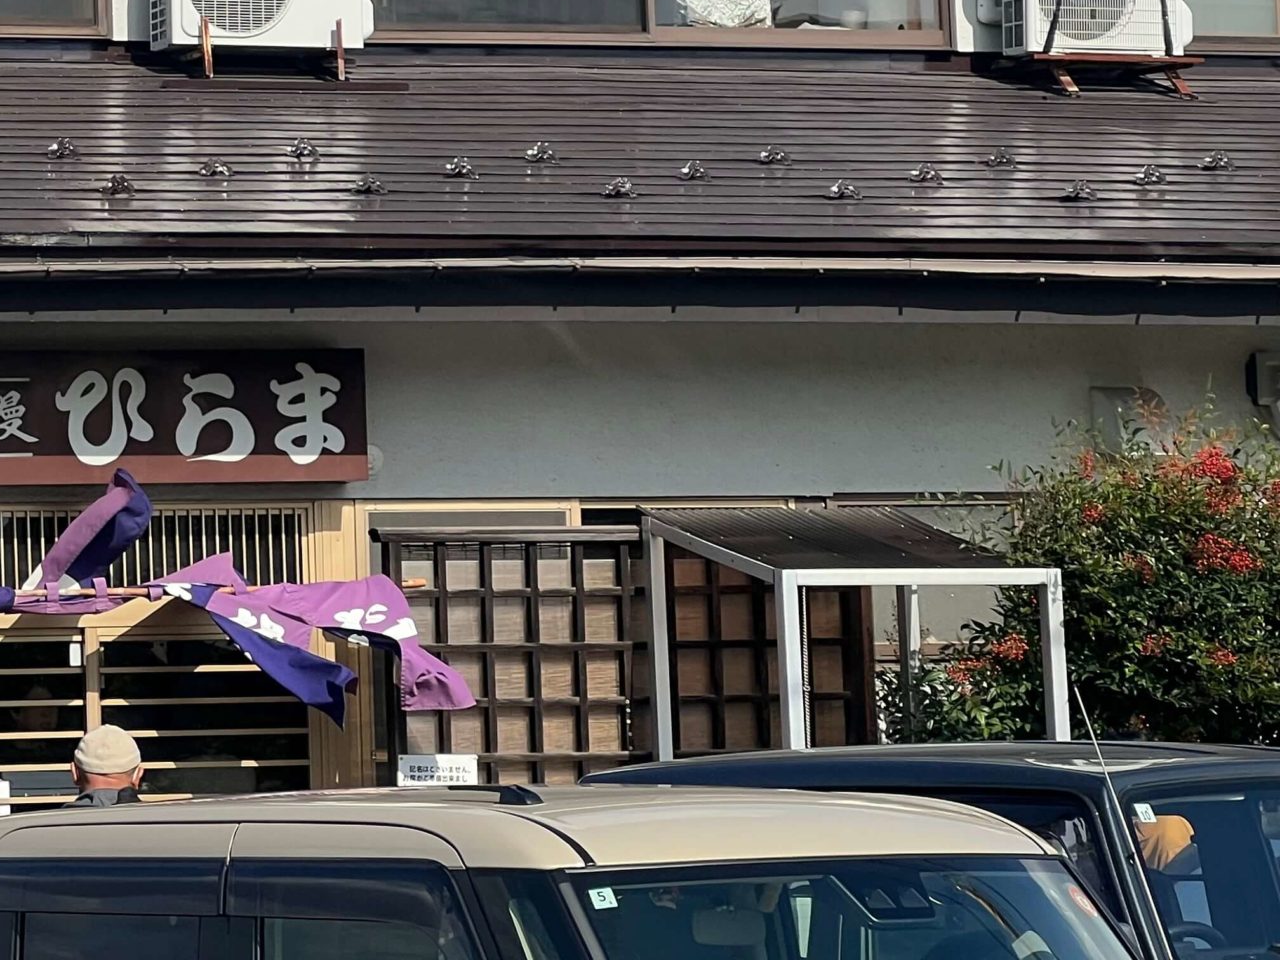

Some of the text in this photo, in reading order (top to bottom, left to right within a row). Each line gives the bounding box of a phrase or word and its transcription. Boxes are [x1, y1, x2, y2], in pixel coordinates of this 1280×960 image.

[55, 361, 345, 466] ひらま
[597, 891, 606, 902] 5
